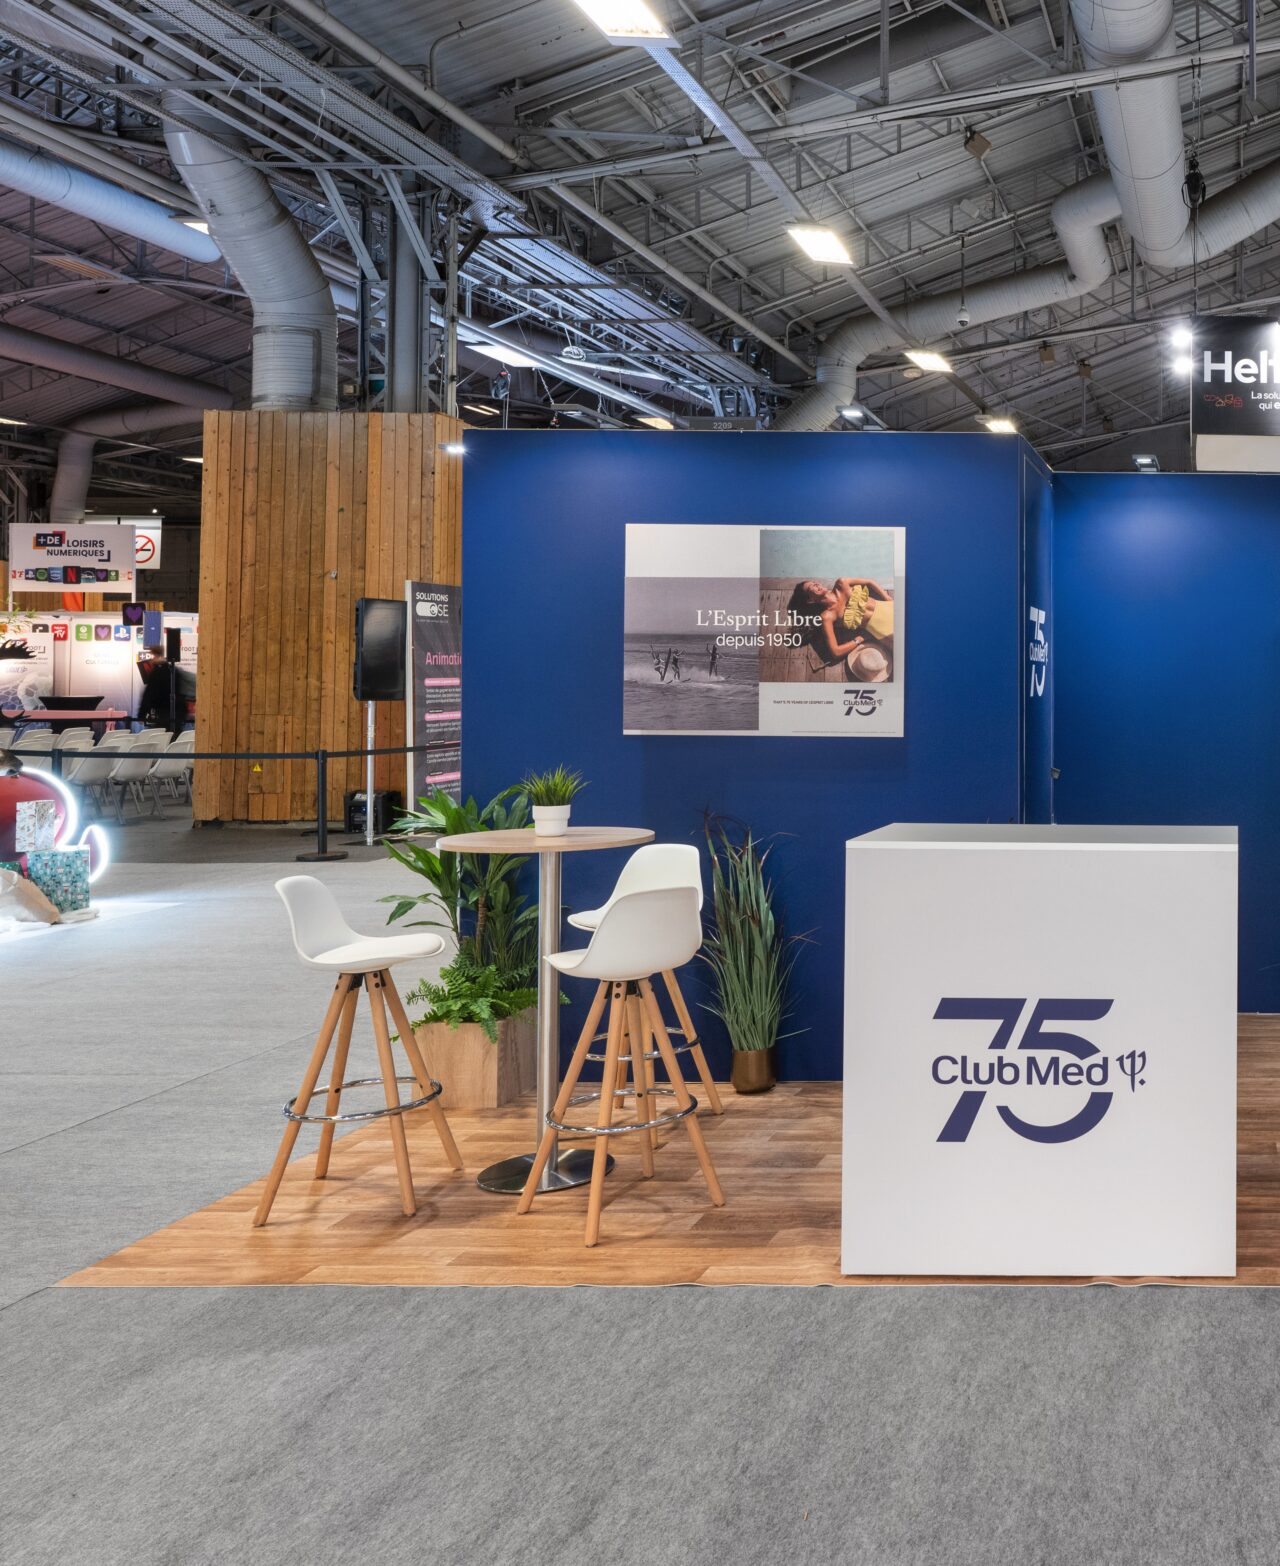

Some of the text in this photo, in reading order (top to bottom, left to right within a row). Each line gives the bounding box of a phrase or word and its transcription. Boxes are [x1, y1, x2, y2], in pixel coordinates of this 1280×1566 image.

[1251, 391, 1262, 399] La
[1259, 401, 1273, 411] qui
[66, 540, 105, 548] LOISIRS
[46, 549, 105, 557] NUMERIQUES
[416, 592, 449, 602] SOLUTIONS
[696, 609, 823, 631] L'Esprit Libre
[716, 633, 802, 650] depuis 1950
[426, 652, 462, 666] Animati
[843, 689, 877, 716] 75
[931, 1054, 1109, 1085] Club Med
[932, 997, 1115, 1144] 75
